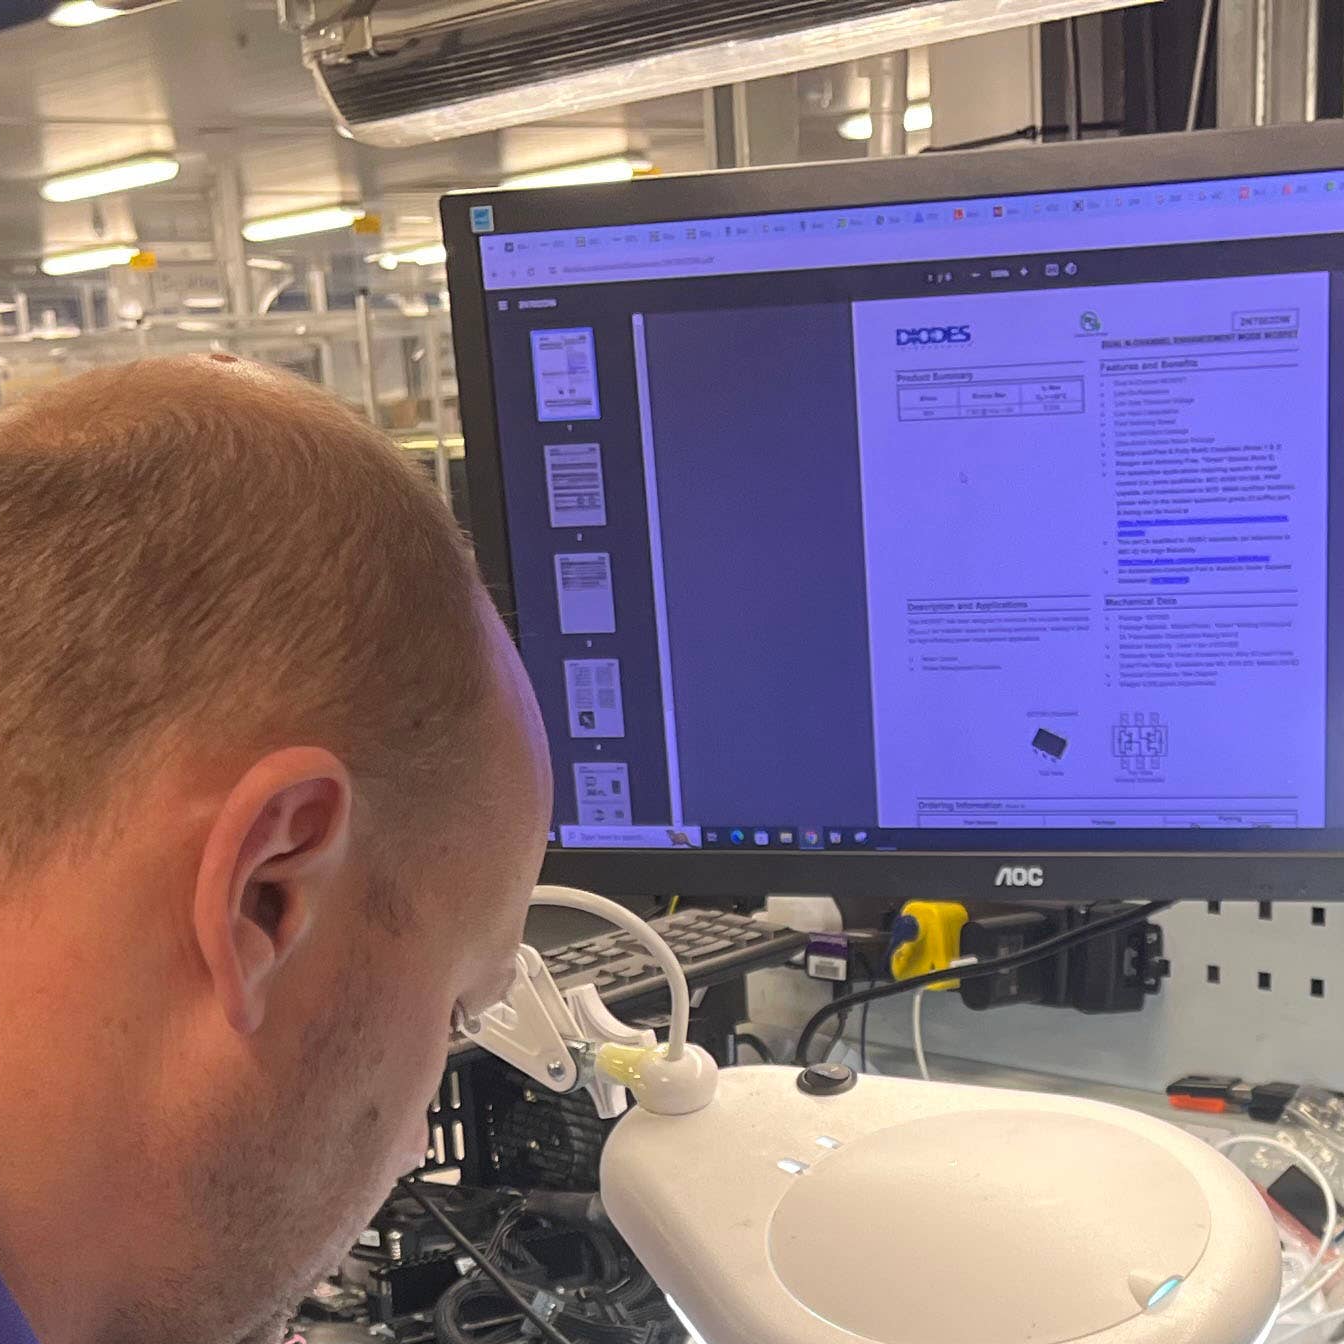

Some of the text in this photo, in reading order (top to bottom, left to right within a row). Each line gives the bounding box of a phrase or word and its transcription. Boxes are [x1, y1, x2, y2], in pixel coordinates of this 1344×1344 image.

[896, 325, 971, 346] DIODES
[918, 801, 1003, 811] Ordering Information
[995, 867, 1044, 887] AOC
